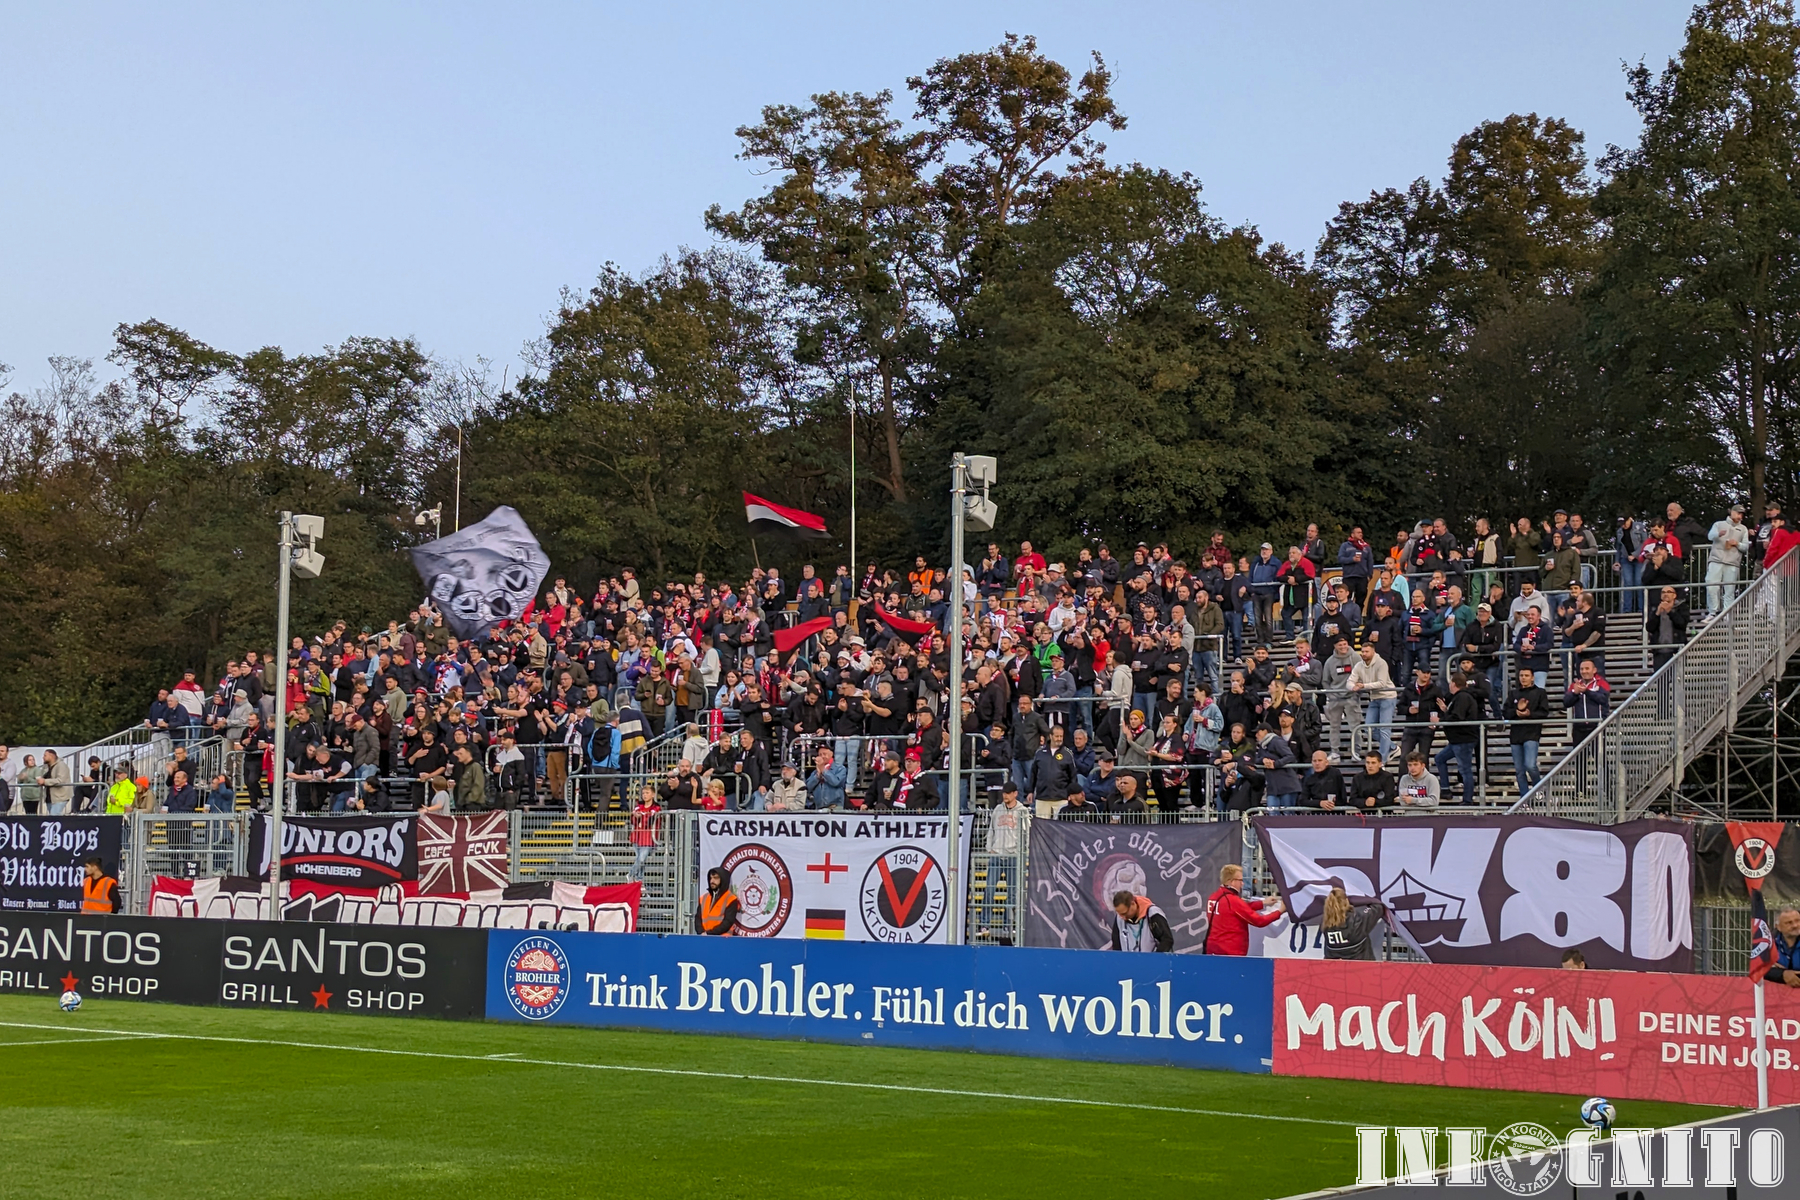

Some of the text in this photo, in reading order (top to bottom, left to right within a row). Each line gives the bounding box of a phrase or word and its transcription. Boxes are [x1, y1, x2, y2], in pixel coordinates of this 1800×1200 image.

[41, 821, 99, 856] Boys
[705, 819, 847, 838] CARSHALTON
[260, 815, 409, 876] JUNIORS
[467, 840, 500, 855] FCVK
[893, 853, 919, 865] 1904
[1, 857, 86, 888] Viktoria
[295, 863, 362, 878] HÖHENBERG
[724, 849, 786, 880] RSHALTON ATHLETIC
[1052, 835, 1115, 901] Meter
[1128, 831, 1173, 869] ohne
[1737, 854, 1761, 876] VIKTORIA
[58, 899, 77, 910] Block
[779, 898, 789, 918] CLUB
[865, 888, 942, 943] VIKTORIA KÖLN
[1327, 931, 1349, 945] ETL
[225, 928, 427, 978] SANTOS
[510, 941, 566, 970] QUELLEN DES
[0, 970, 159, 996] RILL SHOP
[515, 972, 560, 984] BROHLER
[222, 982, 425, 1011] GRILL SHOP
[509, 986, 565, 1016] WOHLSEINS
[586, 961, 1244, 1044] Trink Brohler. Fühl dich wohler.
[1639, 1011, 1800, 1041] DEINE STAD
[1661, 1041, 1800, 1071] DEIN JOB.
